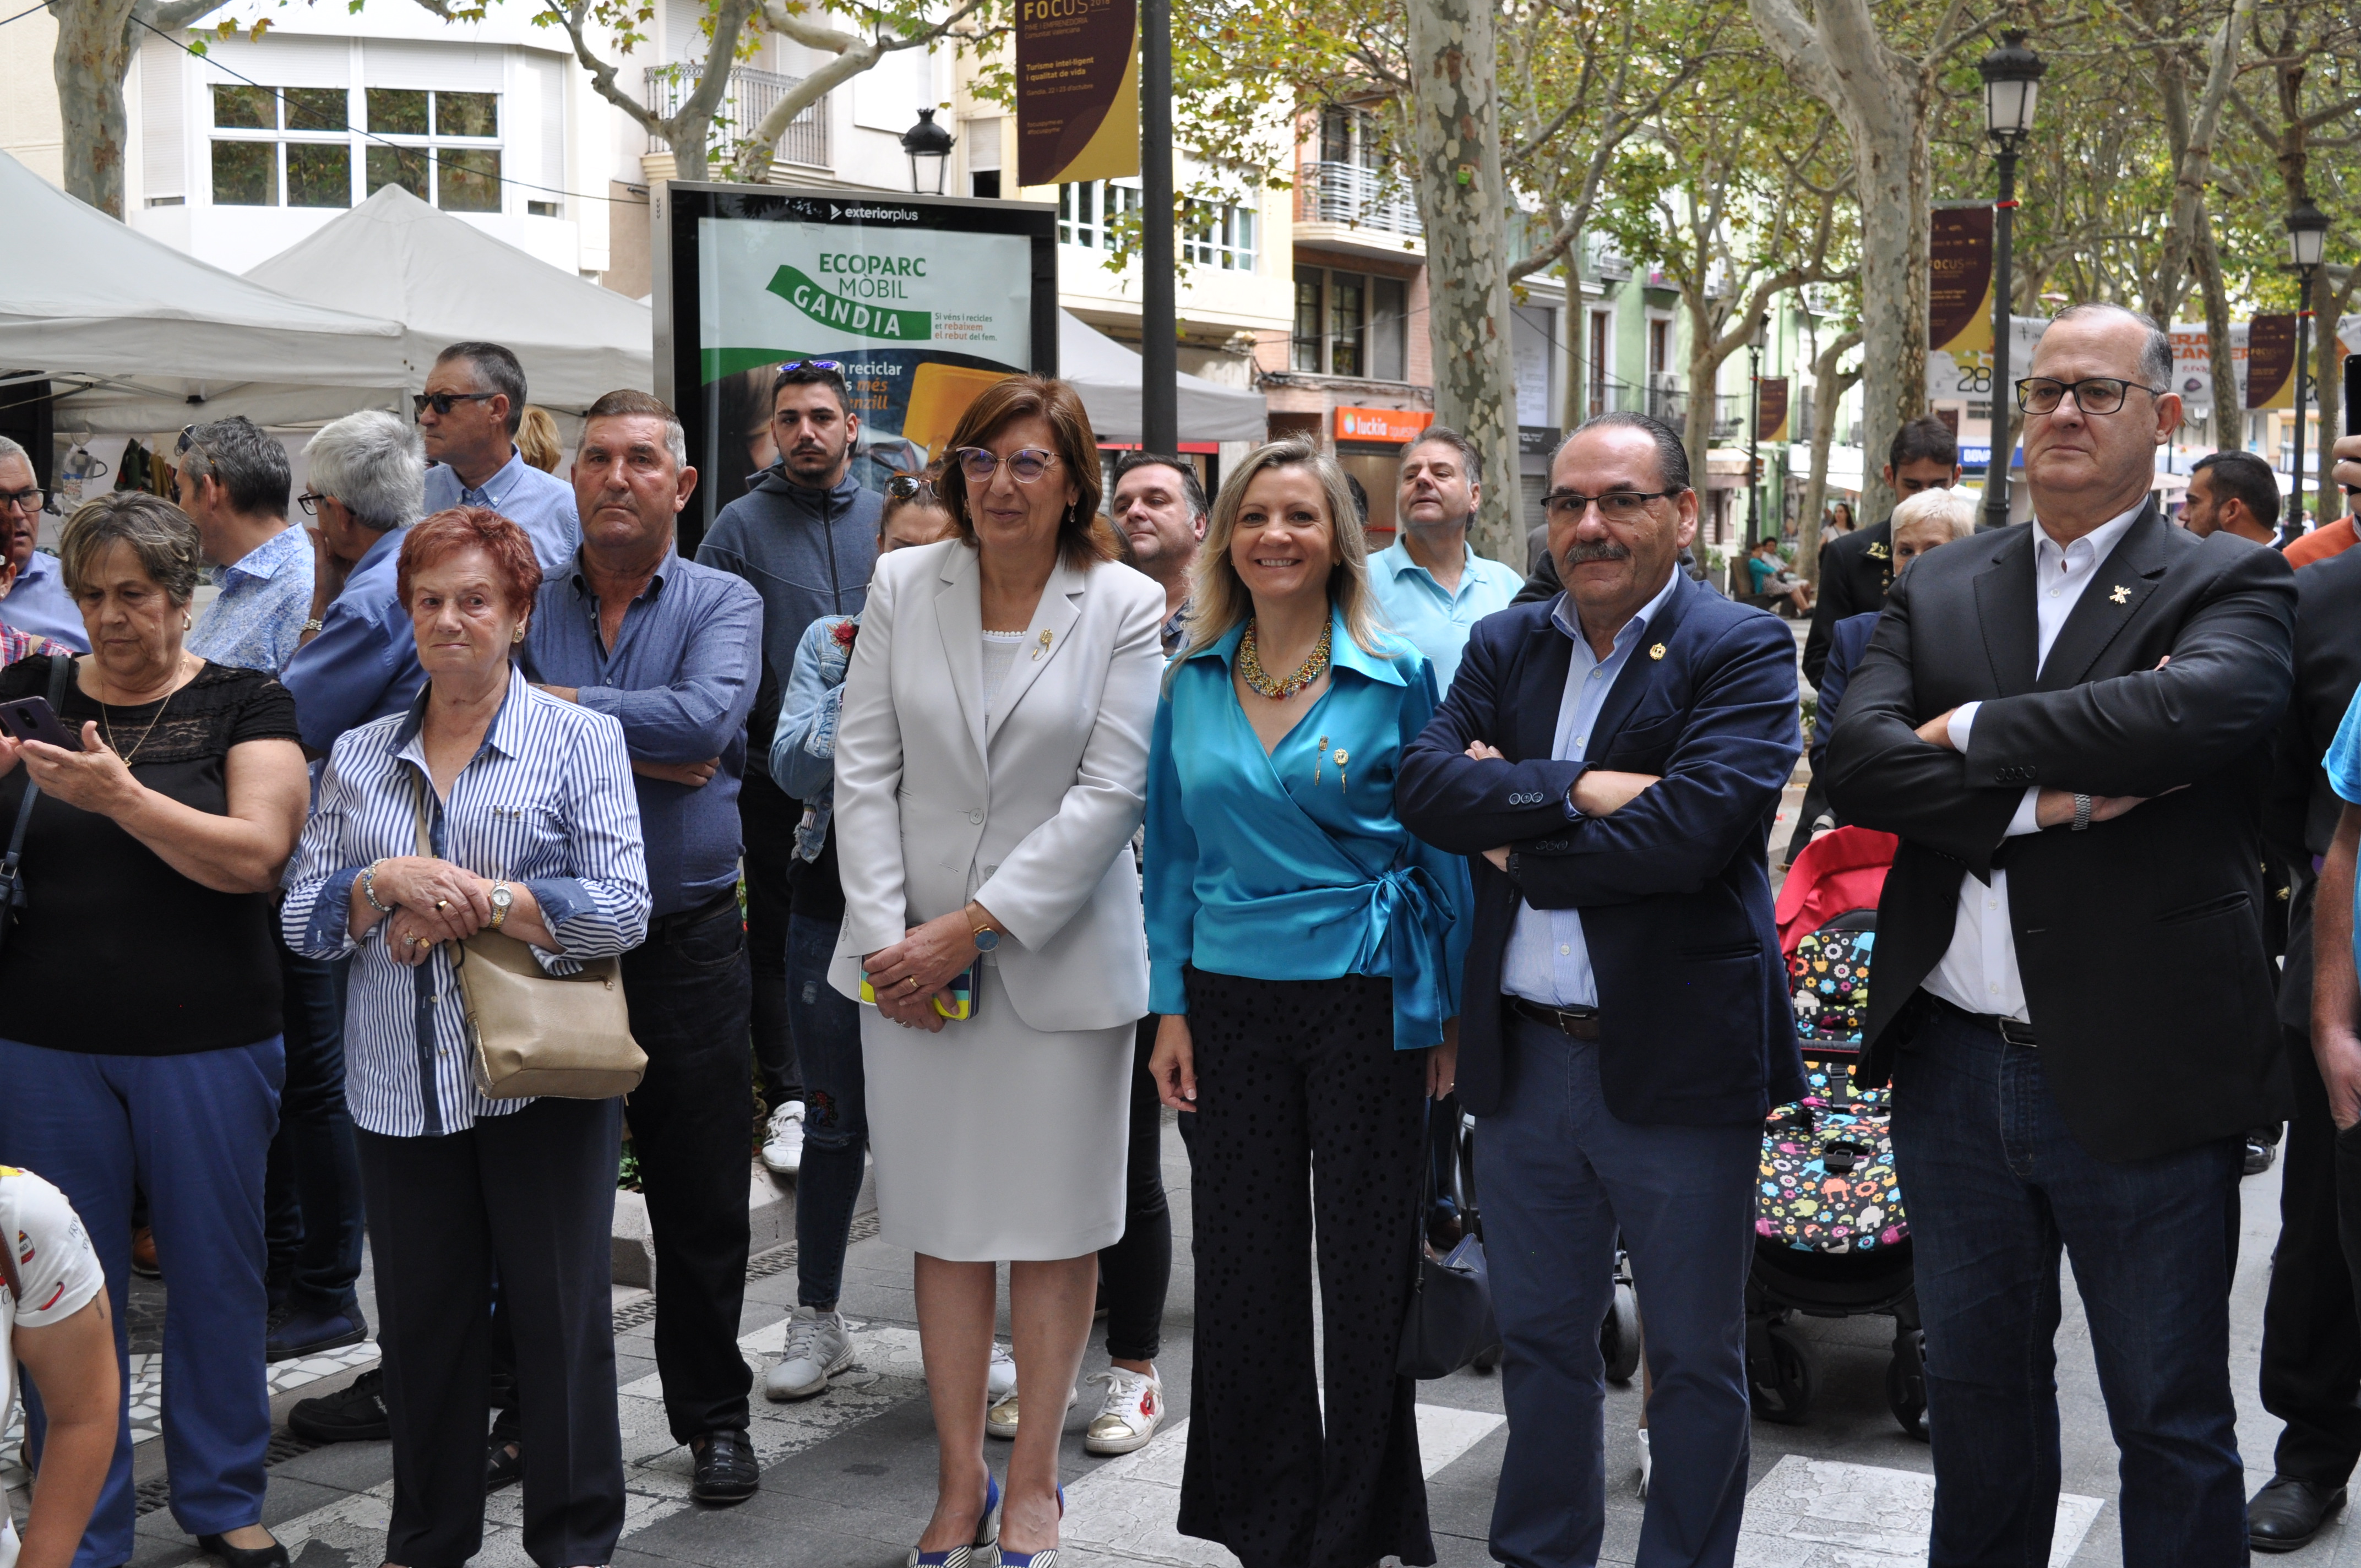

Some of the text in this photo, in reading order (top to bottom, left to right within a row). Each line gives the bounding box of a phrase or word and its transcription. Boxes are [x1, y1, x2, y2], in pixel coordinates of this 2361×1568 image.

[1024, 0, 1088, 21] FOCUS
[1026, 63, 1054, 71] Turisme
[1030, 72, 1058, 82] qualitat
[1070, 68, 1086, 76] vida
[845, 206, 918, 222] exteriorplus
[819, 253, 926, 277] ECOPARC
[1929, 259, 1965, 270] OCUS
[839, 273, 909, 299] MÒBIL
[793, 285, 901, 336] GANDIA
[966, 314, 992, 322] recicles
[944, 322, 983, 331] rebaixem
[935, 330, 943, 339] el
[945, 331, 967, 340] rebut
[849, 361, 902, 375] reciclar
[857, 377, 888, 391] més
[1957, 366, 1992, 393] 28
[849, 395, 888, 409] nzill
[1357, 416, 1387, 435] luckia
